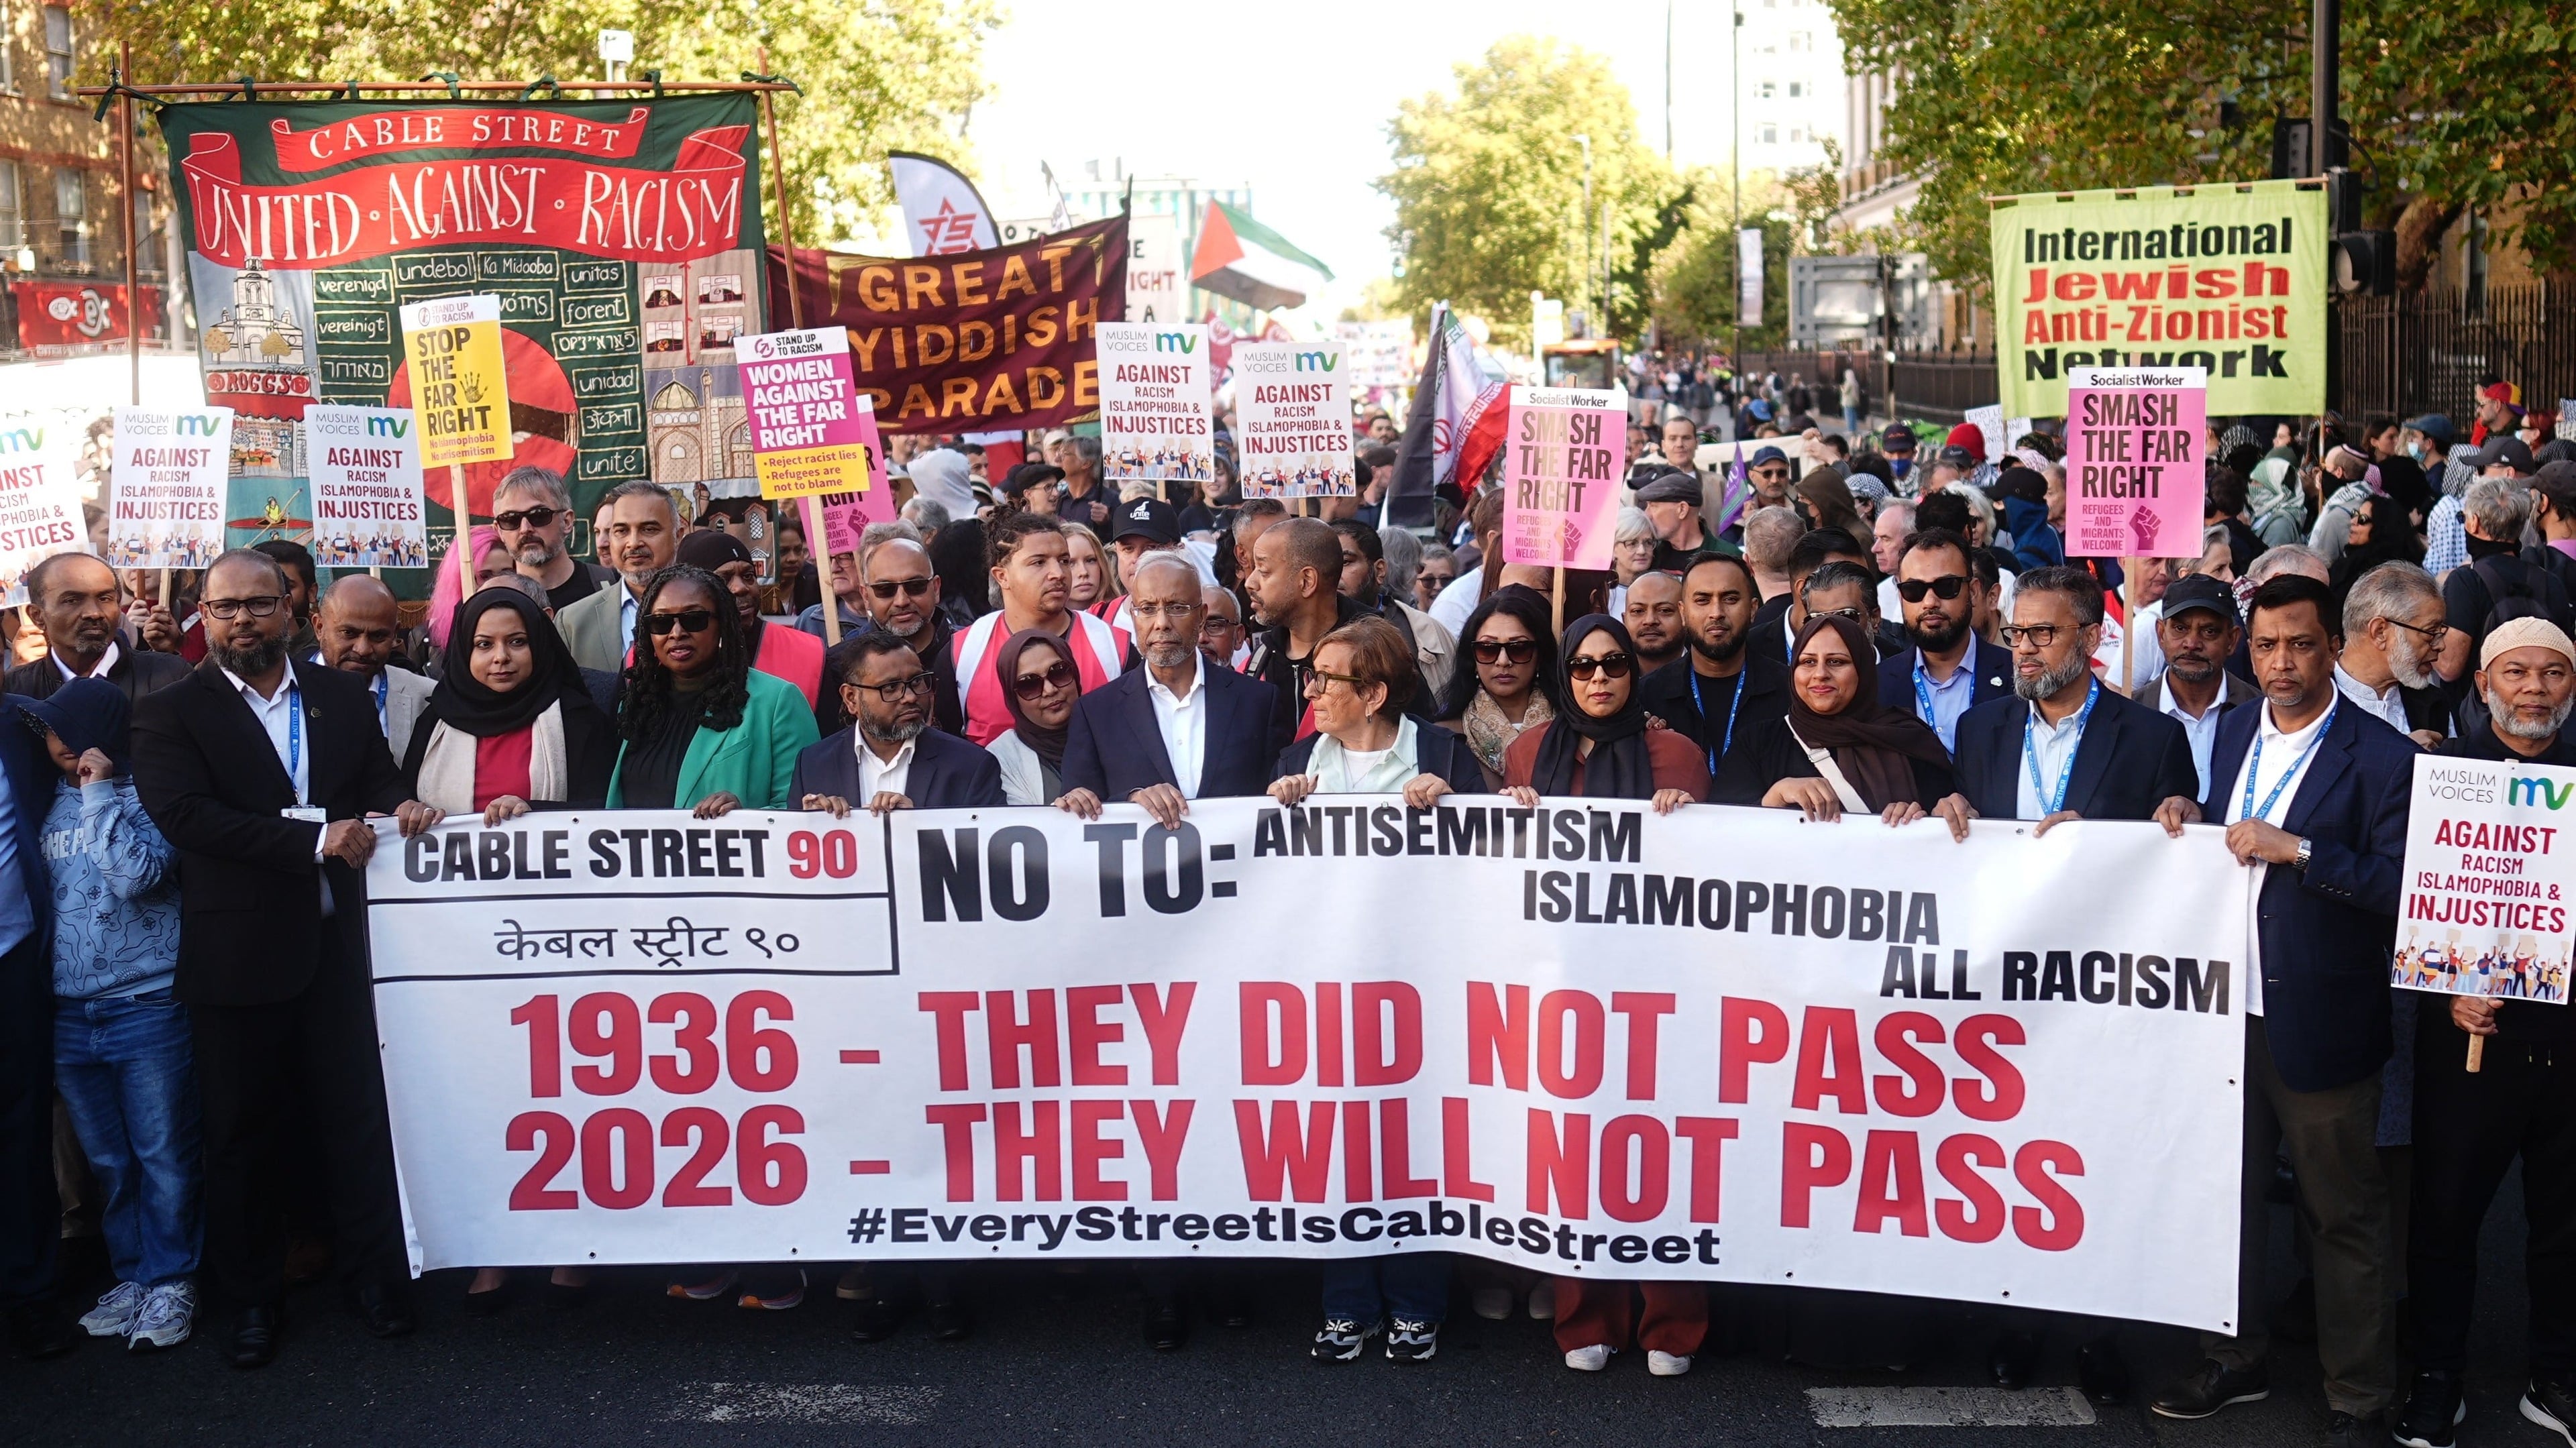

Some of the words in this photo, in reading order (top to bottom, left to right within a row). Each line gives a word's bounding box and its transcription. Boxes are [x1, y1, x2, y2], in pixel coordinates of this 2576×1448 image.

[309, 116, 443, 159] CABLE
[473, 114, 619, 152] STREET
[190, 172, 360, 261] UNITED
[388, 164, 545, 244] AGAINST
[576, 170, 740, 252] RACISM
[2025, 217, 2292, 263] International
[398, 256, 473, 282] undebol
[484, 256, 497, 274] Ka
[503, 255, 553, 275] Midooba
[572, 266, 619, 283] unitas
[319, 272, 387, 298] verenigd
[857, 247, 1071, 313] GREAT
[1130, 271, 1176, 291] IGHT
[2023, 262, 2290, 303] Jewish
[431, 302, 454, 314] STAND
[457, 302, 468, 311] UP
[442, 311, 475, 323] RACISM
[566, 298, 625, 324] forent
[319, 319, 385, 338] vereinigt
[849, 296, 1098, 372] YIDDISH
[2025, 303, 2288, 345] Anti-Zionist
[417, 327, 471, 357] STOP
[776, 335, 803, 346] STAND
[805, 334, 816, 343] UP
[1106, 331, 1148, 341] MUSLIM
[779, 346, 788, 355] TO
[790, 343, 822, 354] RACISM
[1106, 342, 1148, 351] VOICES
[1244, 352, 1287, 361] MUSLIM
[419, 355, 457, 383] THE
[747, 358, 835, 386] WOMEN
[1244, 363, 1287, 372] VOICES
[2025, 344, 2289, 381] Network
[226, 372, 293, 394] ROGGS
[580, 370, 633, 391] unidad
[1116, 364, 1191, 384] AGAINST
[423, 383, 458, 410] FAR
[752, 379, 846, 407] AGAINST
[855, 359, 1098, 419] PARADE
[1135, 386, 1174, 398] RACISM
[1254, 384, 1333, 404] AGAINST
[755, 405, 800, 427] THE
[801, 400, 847, 423] FAR
[1110, 400, 1189, 413] ISLAMOPHOBIA
[1193, 402, 1201, 413] &
[1274, 406, 1316, 418] RACISM
[2082, 393, 2178, 427] SMASH
[125, 414, 168, 423] MUSLIM
[316, 413, 360, 423] MUSLIM
[427, 405, 492, 437] RIGHT
[1106, 415, 1206, 435] INJUSTICES
[1248, 420, 1330, 433] ISLAMOPHOBIA
[1334, 419, 1342, 431] &
[1521, 410, 1601, 445] SMASH
[125, 425, 168, 435] VOICES
[317, 425, 360, 435] VOICES
[759, 423, 826, 449] RIGHT
[429, 439, 437, 449] No
[439, 433, 495, 447] Islamophobia
[1245, 434, 1348, 454] INJUSTICES
[2082, 430, 2132, 462] THE
[2142, 430, 2191, 463] FAR
[131, 448, 211, 467] AGAINST
[327, 447, 402, 468] AGAINST
[431, 451, 439, 461] No
[441, 447, 495, 459] antisemitism
[586, 449, 636, 474] unité
[769, 455, 802, 468] Reject
[805, 453, 836, 465] racist
[839, 450, 857, 461] lies
[1519, 445, 1560, 478] THE
[1567, 447, 1612, 480] FAR
[150, 471, 190, 482] RACISM
[347, 470, 386, 483] RACISM
[771, 468, 820, 482] Refugees
[823, 467, 841, 476] are
[2082, 466, 2164, 499] RIGHT
[121, 486, 203, 498] ISLAMOPHOBIA
[207, 487, 215, 498] &
[321, 484, 400, 498] ISLAMOPHOBIA
[404, 488, 413, 499] &
[774, 483, 793, 493] not
[795, 482, 806, 490] to
[808, 477, 843, 490] blame
[1517, 479, 1587, 512] RIGHT
[54, 504, 64, 518] &
[116, 501, 219, 520] INJUSTICES
[318, 500, 418, 521] INJUSTICES
[1130, 510, 1150, 518] unite
[2082, 504, 2124, 515] REFUGEES
[1517, 514, 1552, 526] REFUGEES
[2094, 516, 2111, 526] AND
[3, 520, 74, 551] STICES
[1526, 528, 1542, 537] AND
[2081, 528, 2125, 539] MIGRANTS
[1515, 537, 1551, 549] MIGRANTS
[2082, 539, 2123, 551] WELCOME
[1515, 548, 1550, 560] WELCOME
[2429, 769, 2496, 787] MUSLIM
[2428, 785, 2493, 803] VOICES
[1253, 806, 1641, 864] ANTISEMITISM
[2434, 819, 2557, 854] AGAINST
[403, 830, 570, 883] CABLE
[588, 829, 769, 878] STREET
[787, 830, 858, 880] 90
[2461, 854, 2524, 875] RACISM
[917, 826, 1050, 923] NO
[1083, 822, 1236, 917] TO:
[2417, 871, 2542, 899] ISLAMOPHOBIA
[2547, 883, 2561, 901] &
[1524, 870, 1941, 946] ISLAMOPHOBIA
[2407, 893, 2566, 933] INJUSTICES
[494, 919, 618, 961] केबल
[631, 916, 729, 968] स्ट्रीट
[746, 927, 800, 960] ९०
[1880, 945, 1982, 1001] ALL
[2002, 950, 2231, 1015] RACISM
[510, 990, 798, 1099] 1936
[918, 981, 1197, 1091] THEY
[1238, 981, 1423, 1087] DID
[1466, 981, 1675, 1101] NOT
[1719, 996, 2026, 1123] PASS
[505, 1104, 807, 1211] 2026
[925, 1099, 1196, 1203] THEY
[1232, 1097, 1495, 1203] WILL
[1525, 1105, 1738, 1225] NOT
[1780, 1120, 2084, 1252] PASS
[847, 1202, 1720, 1266] #EveryStreetIsCableStreet
